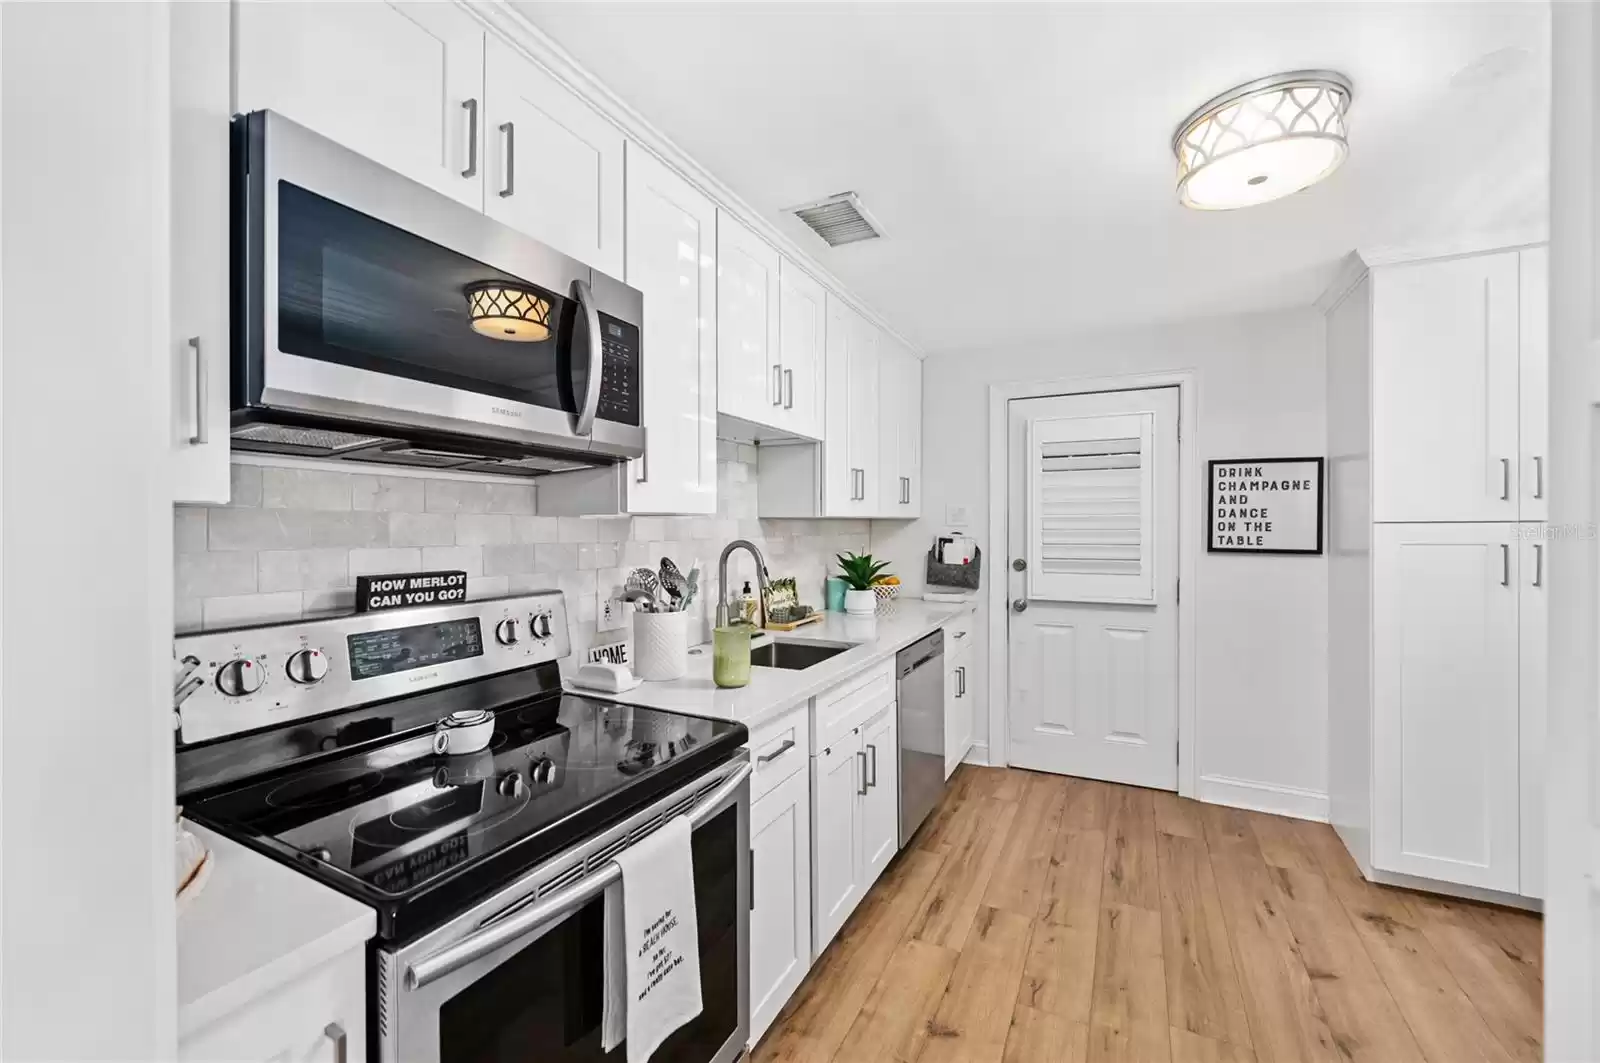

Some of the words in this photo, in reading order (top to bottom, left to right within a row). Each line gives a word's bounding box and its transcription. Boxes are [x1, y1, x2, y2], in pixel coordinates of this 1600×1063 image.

[1218, 467, 1263, 478] DRINK
[1218, 480, 1311, 491] CHAMPAGNE
[1218, 494, 1248, 505] AND
[1218, 508, 1268, 518] DANCE
[1218, 521, 1236, 532] ON
[1244, 521, 1272, 532] THE
[1218, 535, 1264, 546] TABLE
[370, 579, 407, 592] HOW
[409, 575, 465, 589] MERLOT
[369, 594, 402, 608] CAN
[405, 591, 435, 604] YOU
[437, 589, 464, 601] GO?
[593, 644, 628, 664] HOME
